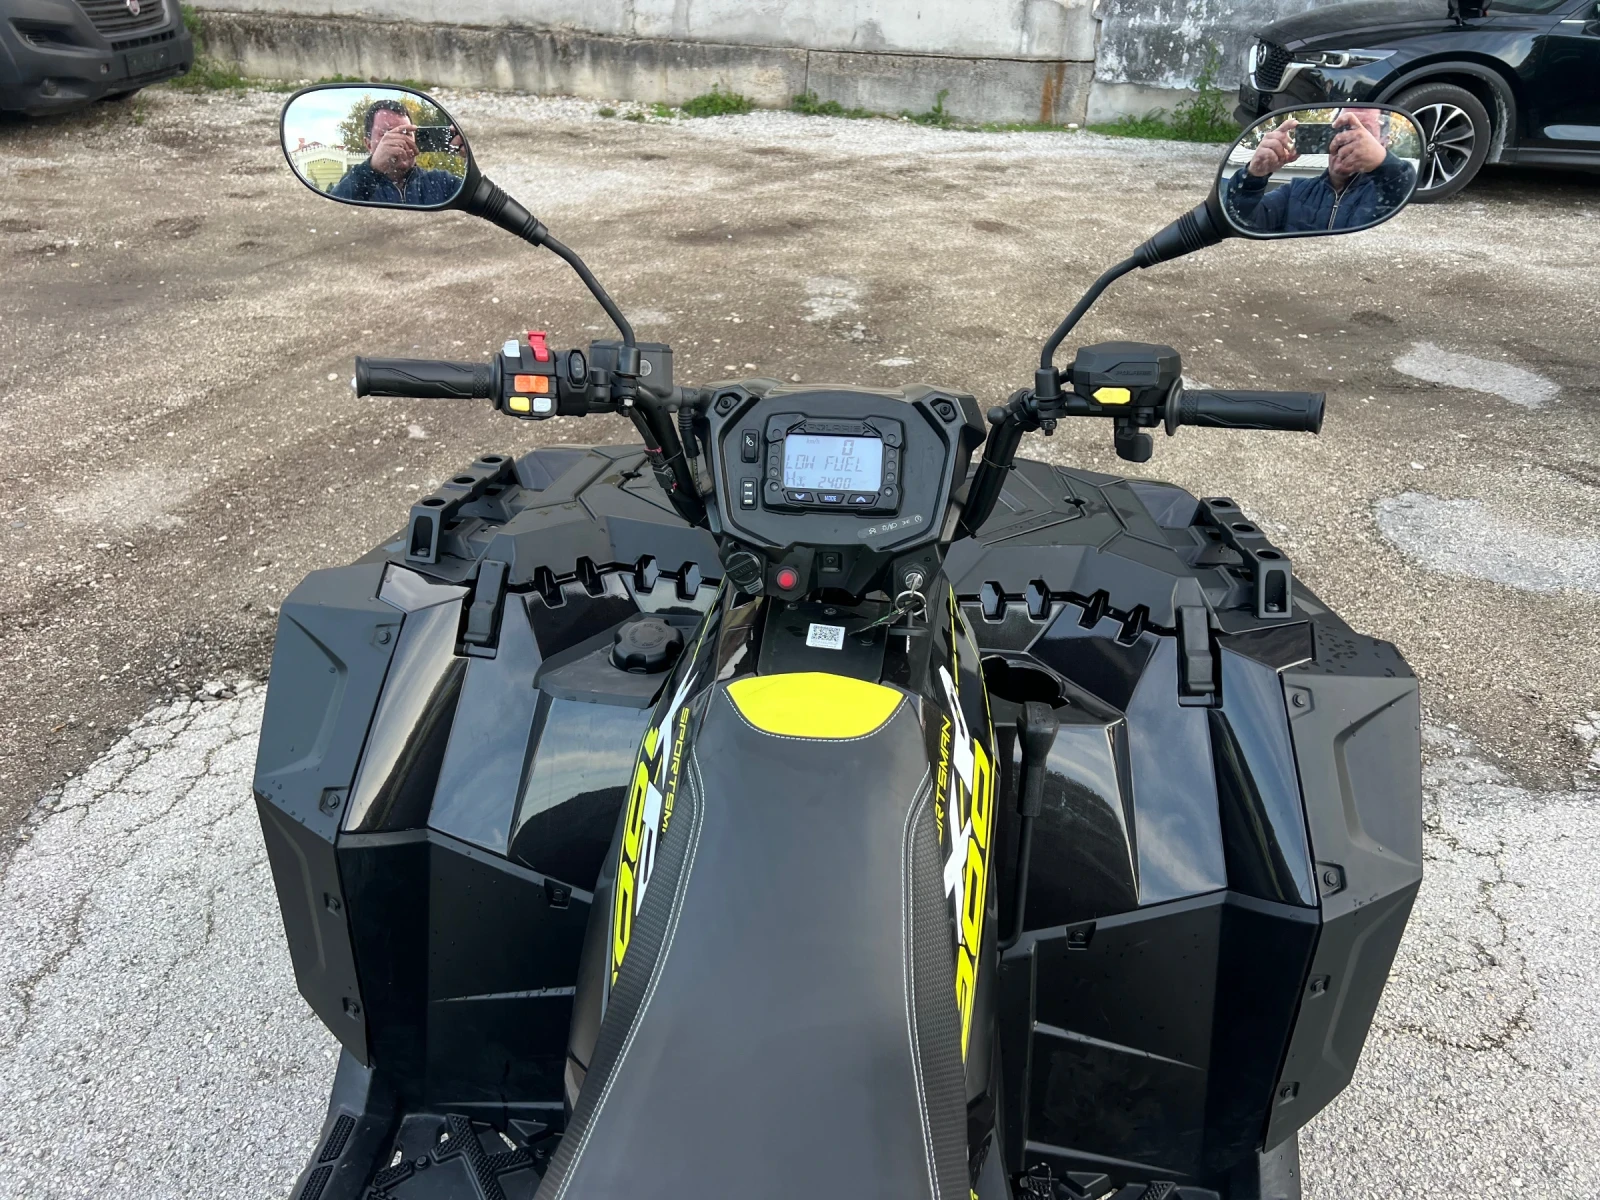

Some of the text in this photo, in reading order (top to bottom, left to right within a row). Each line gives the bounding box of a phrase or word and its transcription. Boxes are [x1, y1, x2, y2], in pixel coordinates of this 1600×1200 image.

[806, 423, 862, 433] POLARIS
[785, 454, 863, 473] LOW FUEL
[818, 476, 852, 489] 2400
[661, 707, 688, 833] SPORTSM
